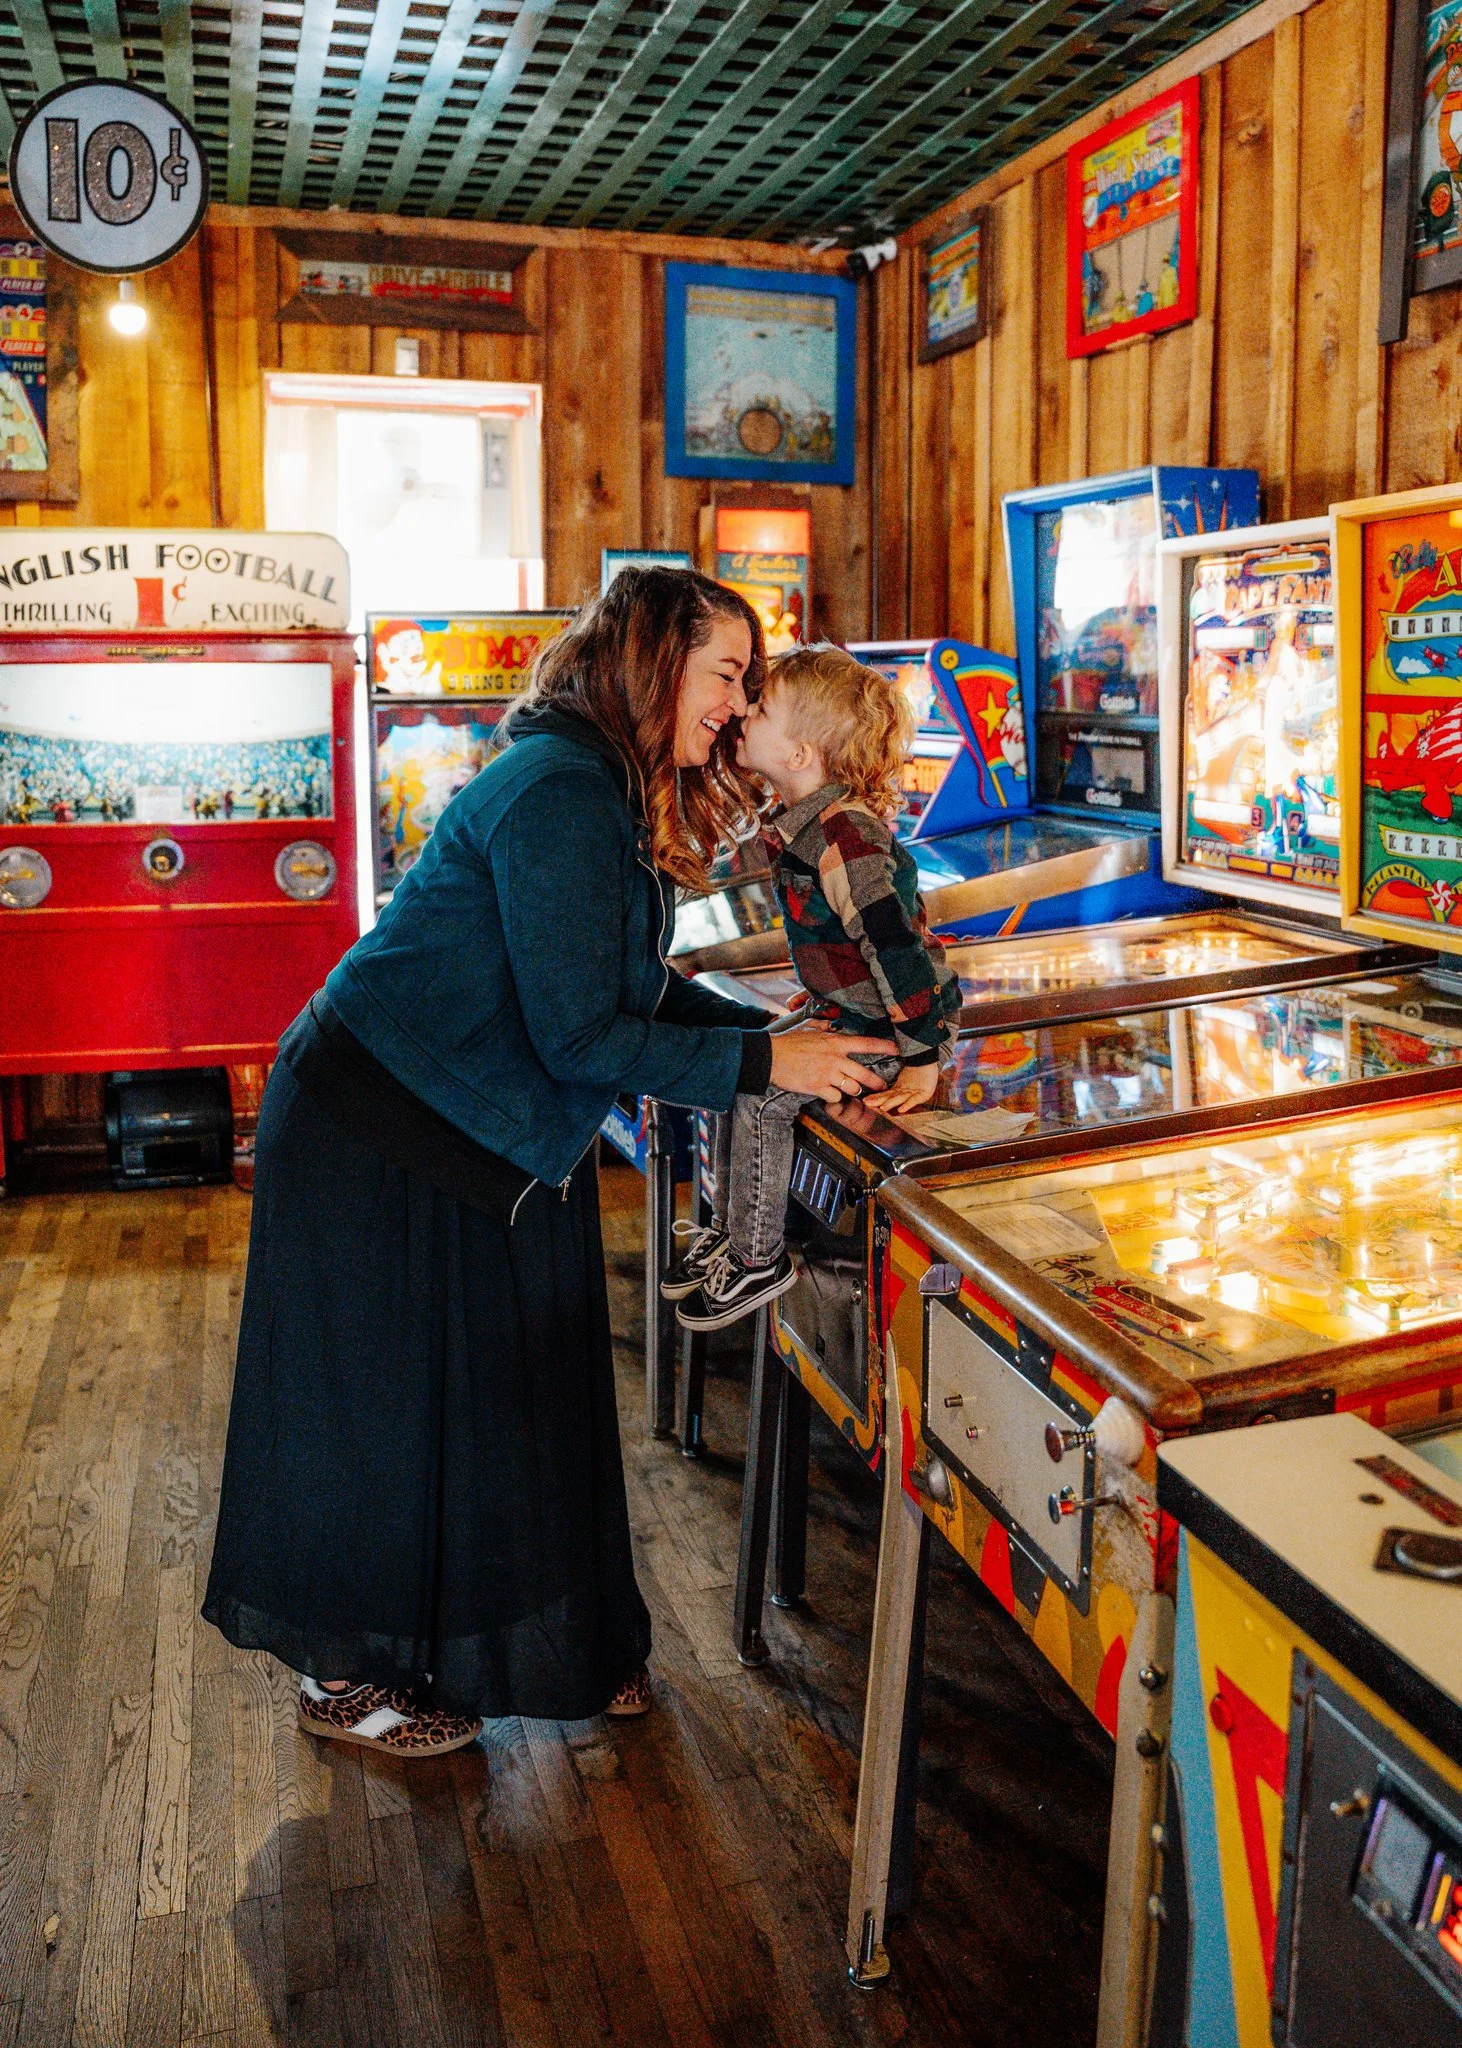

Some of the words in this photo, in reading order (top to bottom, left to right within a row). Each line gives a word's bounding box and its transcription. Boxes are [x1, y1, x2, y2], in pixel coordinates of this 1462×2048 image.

[45, 117, 189, 226] 10¢
[2, 278, 32, 291] PLAYER
[1391, 538, 1438, 579] Bally
[155, 544, 338, 605] FOOTBALL
[2, 602, 112, 624] THRILLING
[211, 603, 305, 625] EXCITING
[463, 675, 504, 690] RING
